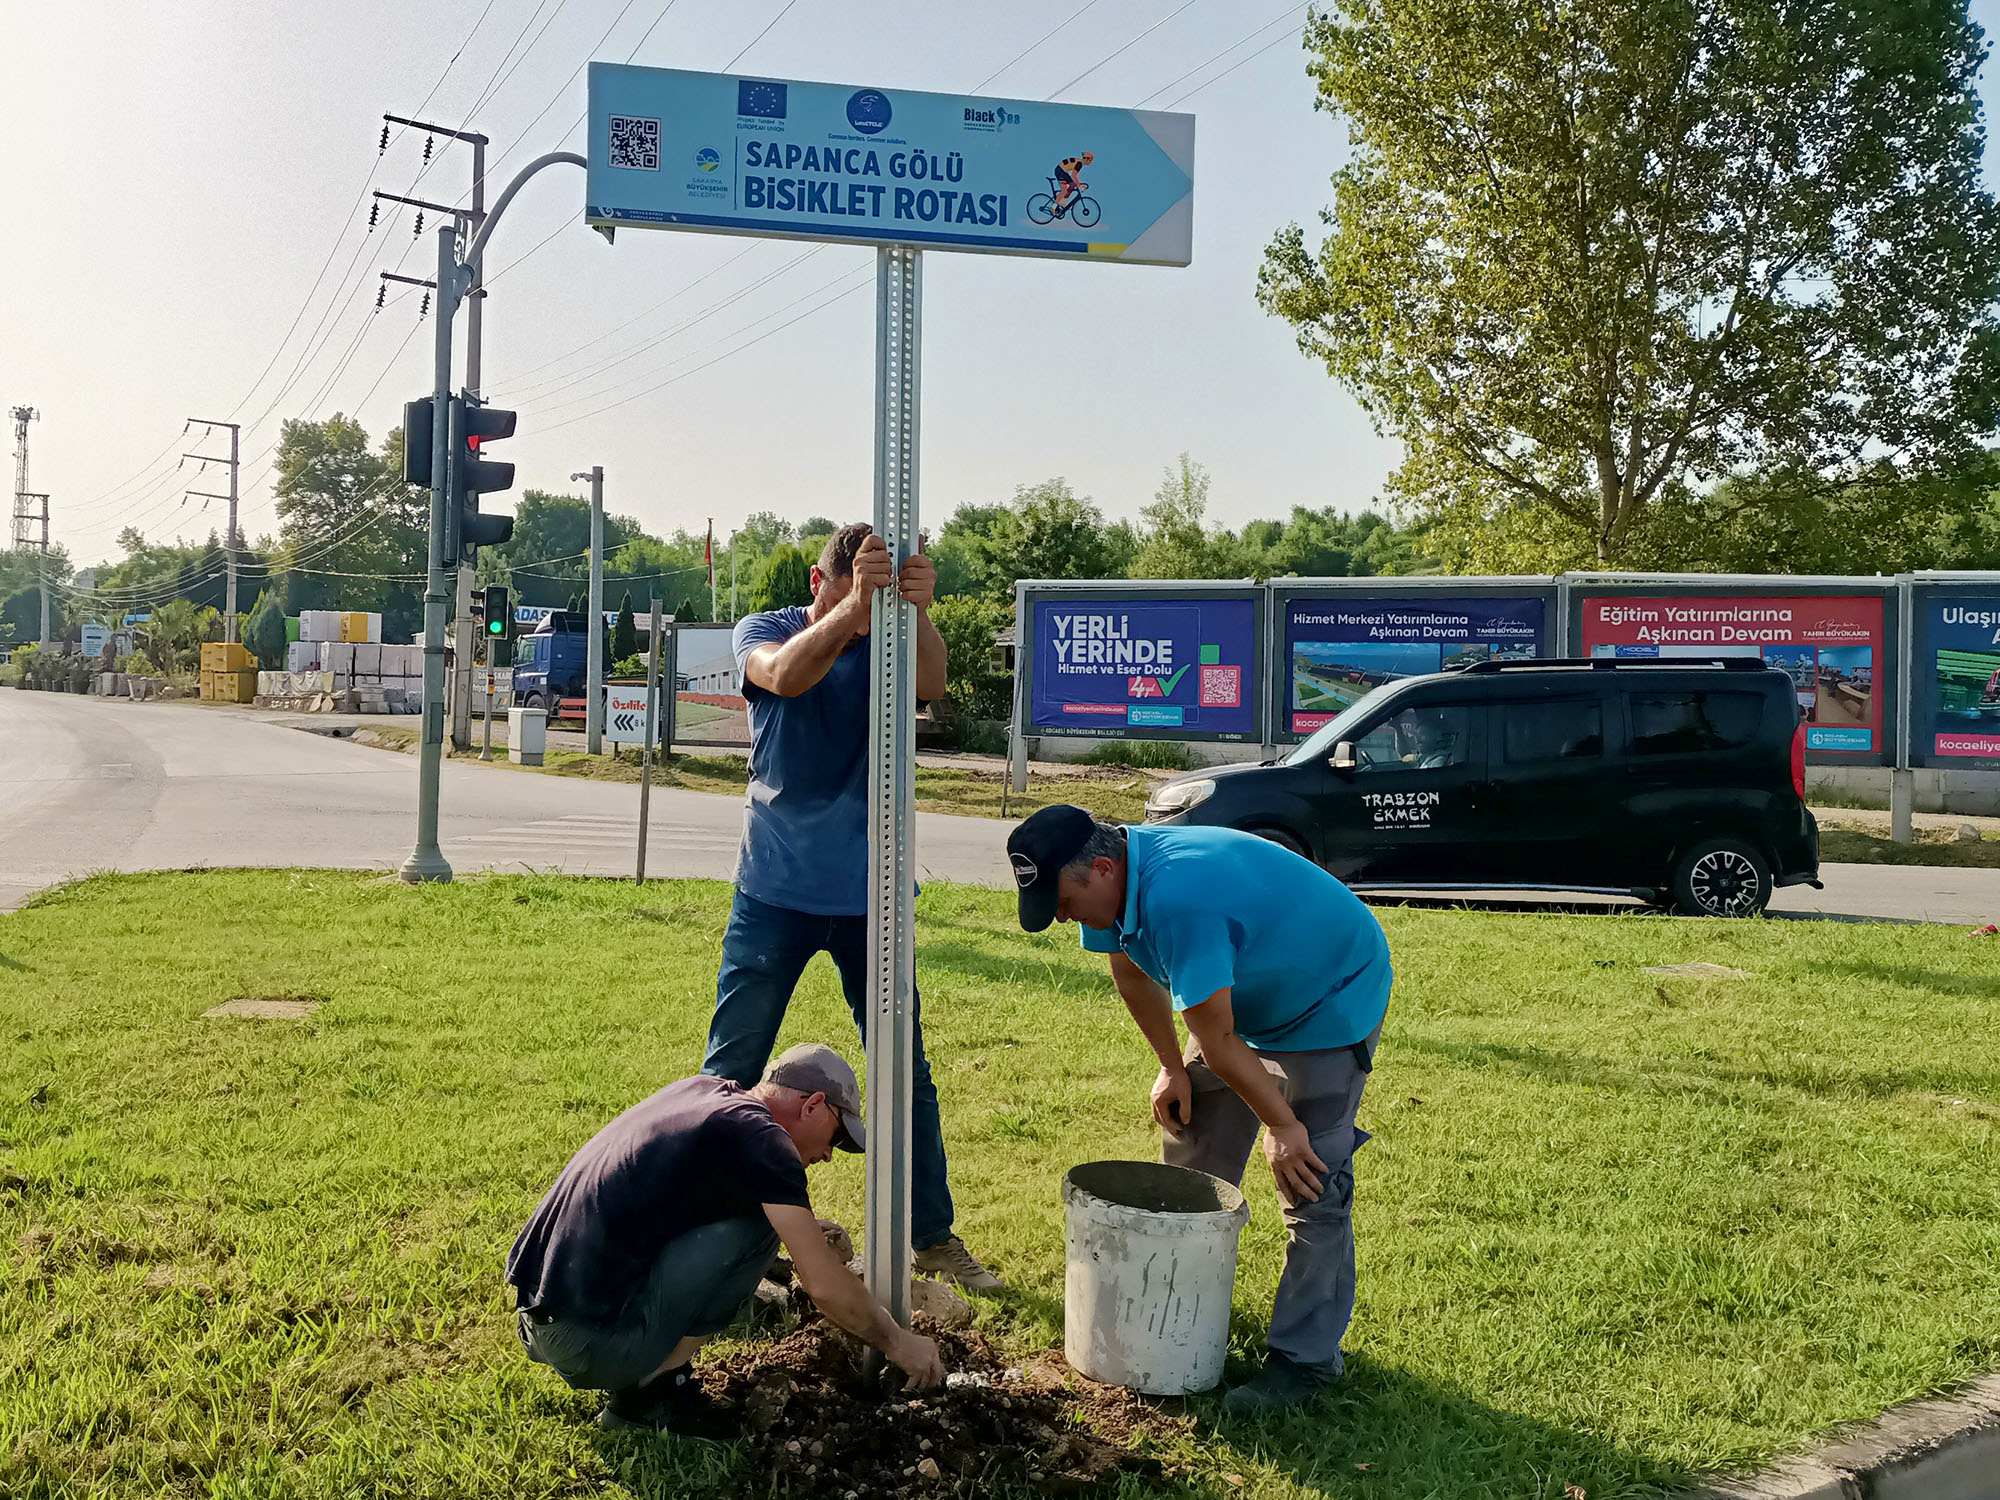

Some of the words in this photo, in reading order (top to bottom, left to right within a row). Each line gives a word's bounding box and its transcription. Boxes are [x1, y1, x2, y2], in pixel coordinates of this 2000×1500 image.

[964, 108, 995, 123] Black
[736, 123, 766, 132] EUROPEAN
[746, 141, 880, 176] SAPANCA
[889, 148, 964, 183] GÖLÜ
[893, 186, 1008, 227] ROTASI
[1293, 613, 1335, 625] Hizmet
[1337, 613, 1385, 625] Merkezi
[1387, 613, 1468, 626] Yatırımlarına
[1600, 606, 1659, 625] Eğitim
[1664, 606, 1792, 623] Yatırımlarına
[1942, 606, 2000, 628] Ulaşı
[1369, 626, 1420, 640] Aşkınan
[1423, 626, 1468, 638] Devam
[1636, 625, 1715, 644] Aşkınan
[1720, 625, 1792, 641] Devam
[1826, 628, 1870, 637] BÜYÜKAKIN
[1058, 663, 1098, 675] Hizmet
[1100, 665, 1114, 675] ve
[1116, 664, 1142, 675] Eser
[1144, 664, 1172, 675] Dolu
[1130, 676, 1145, 698] 4
[612, 697, 647, 711] Özdile
[634, 719, 640, 727] 8
[1361, 792, 1440, 807] TRABZON
[1373, 807, 1431, 822] EKMEK
